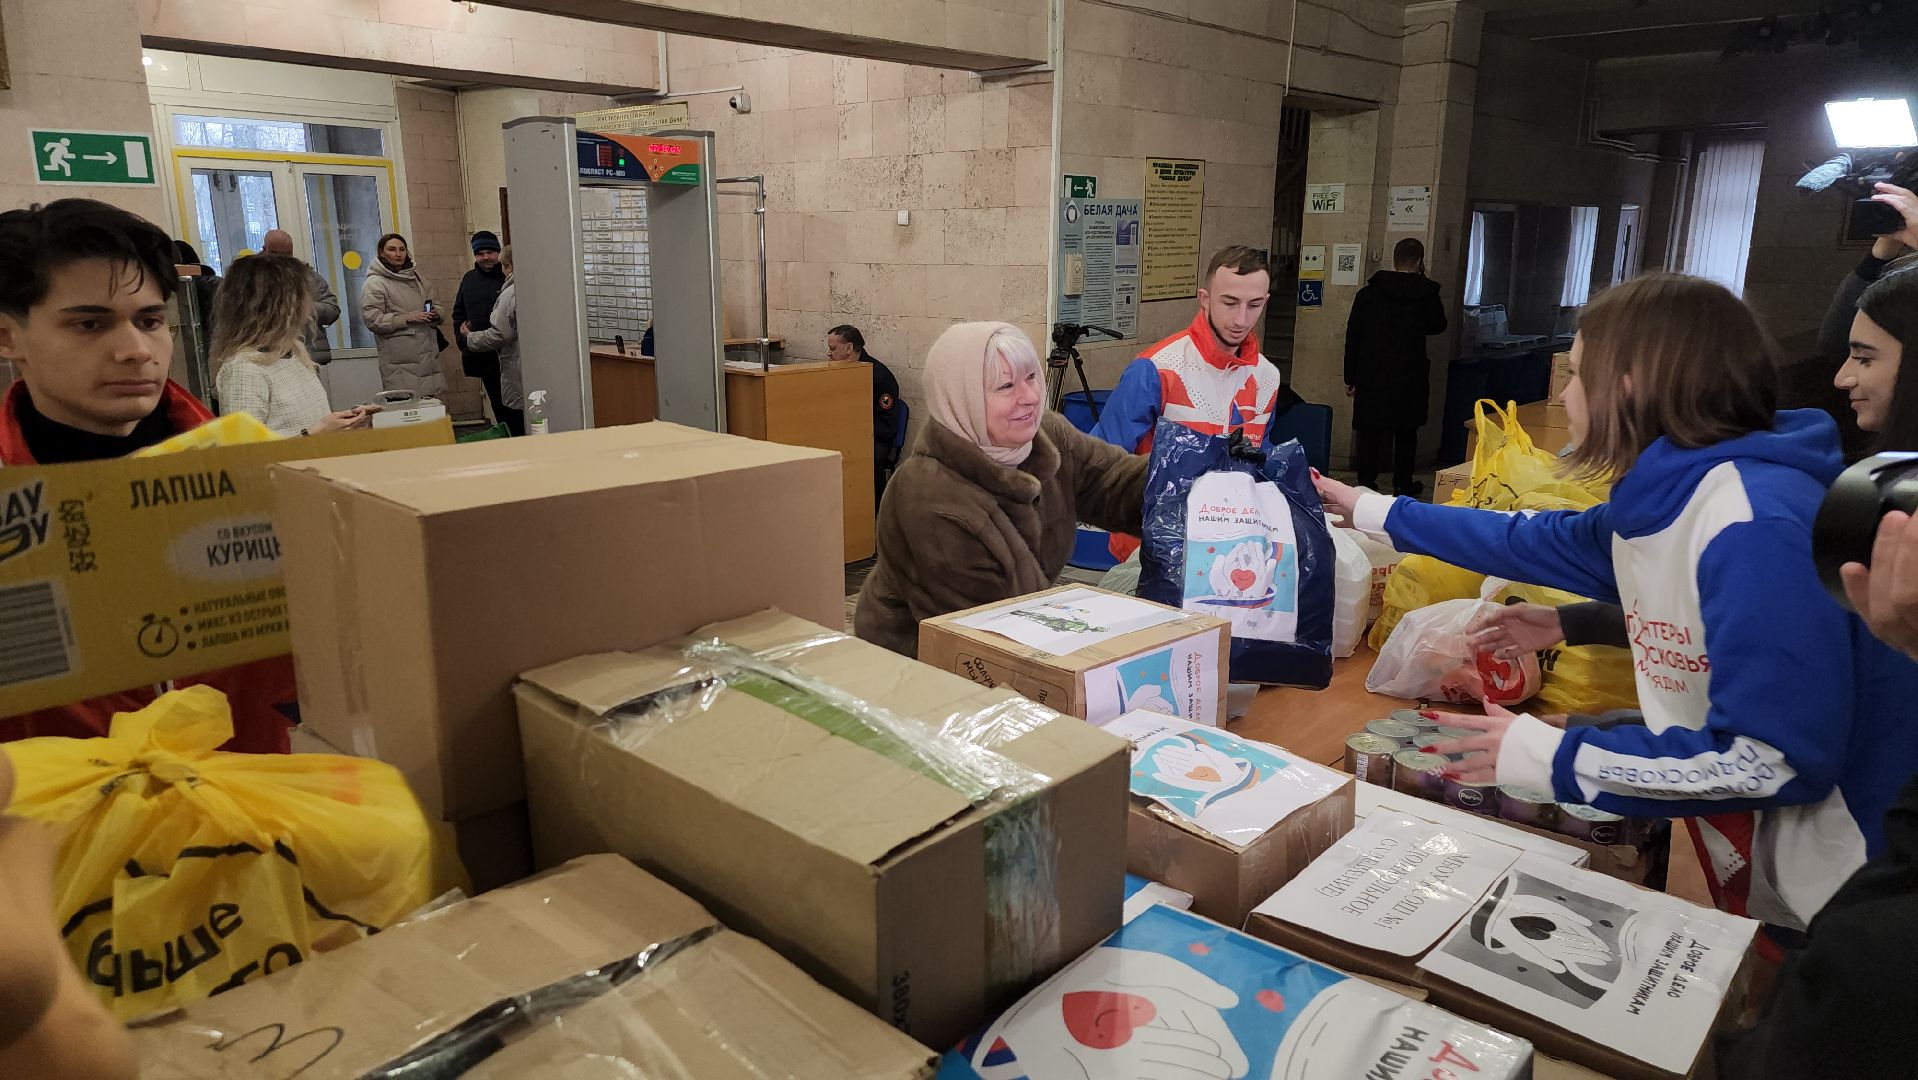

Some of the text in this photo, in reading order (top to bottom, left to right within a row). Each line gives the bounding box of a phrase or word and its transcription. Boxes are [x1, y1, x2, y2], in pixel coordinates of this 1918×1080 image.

[1312, 192, 1330, 200] FREE
[1084, 204, 1138, 218] БЕЛАЯ ДАЧА
[1312, 199, 1337, 211] WiFi
[129, 470, 236, 510] ЛАПША
[1241, 506, 1262, 515] ДЕЛ
[1198, 515, 1230, 523] НАШИМ
[202, 631, 239, 648] ЛАПША
[1626, 931, 1685, 1015] НАШИМ ЗАЩИТНИКАМ
[1666, 938, 1711, 998] ДОБРОЕ ДЕЛО
